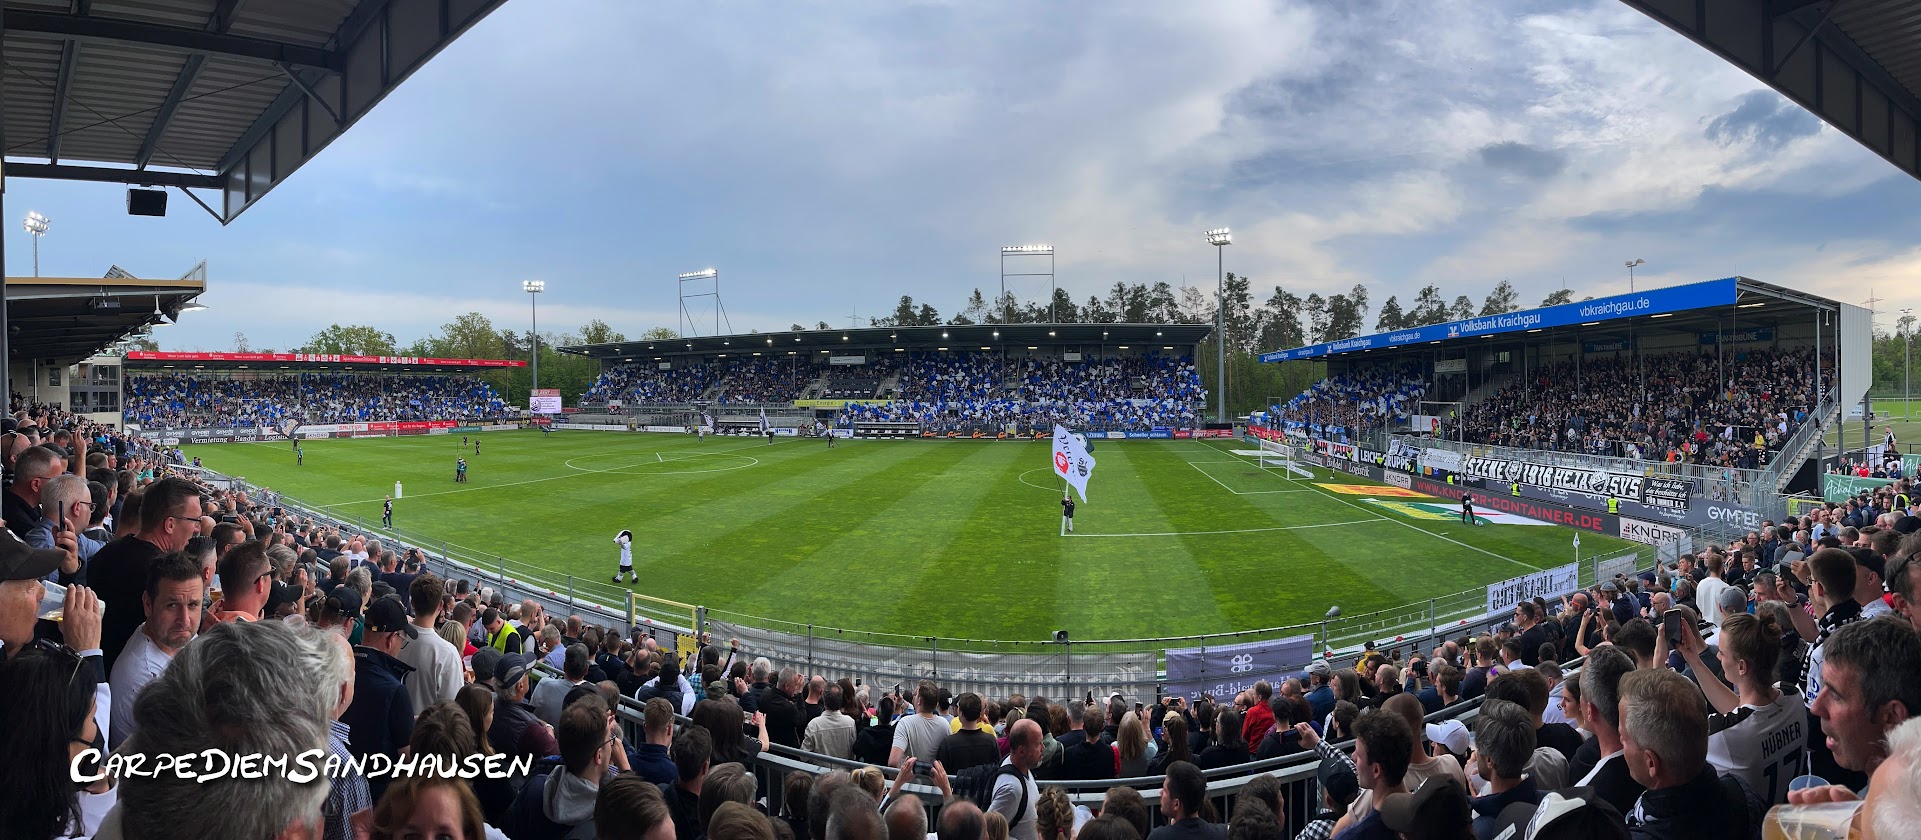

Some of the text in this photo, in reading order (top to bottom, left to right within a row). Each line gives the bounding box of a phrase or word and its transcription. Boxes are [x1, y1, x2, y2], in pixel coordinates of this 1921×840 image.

[1460, 314, 1541, 333] Volksbank Kraichgau
[1579, 297, 1650, 317] vbkraichgau.de
[1468, 458, 1506, 479] SZENE
[1554, 468, 1590, 490] HEJA
[1609, 477, 1641, 499] SVS
[1417, 481, 1603, 532] WWW.KNORR-CONTAINER.DE
[1761, 721, 1802, 760] HÜBNER
[1764, 745, 1803, 805] 17
